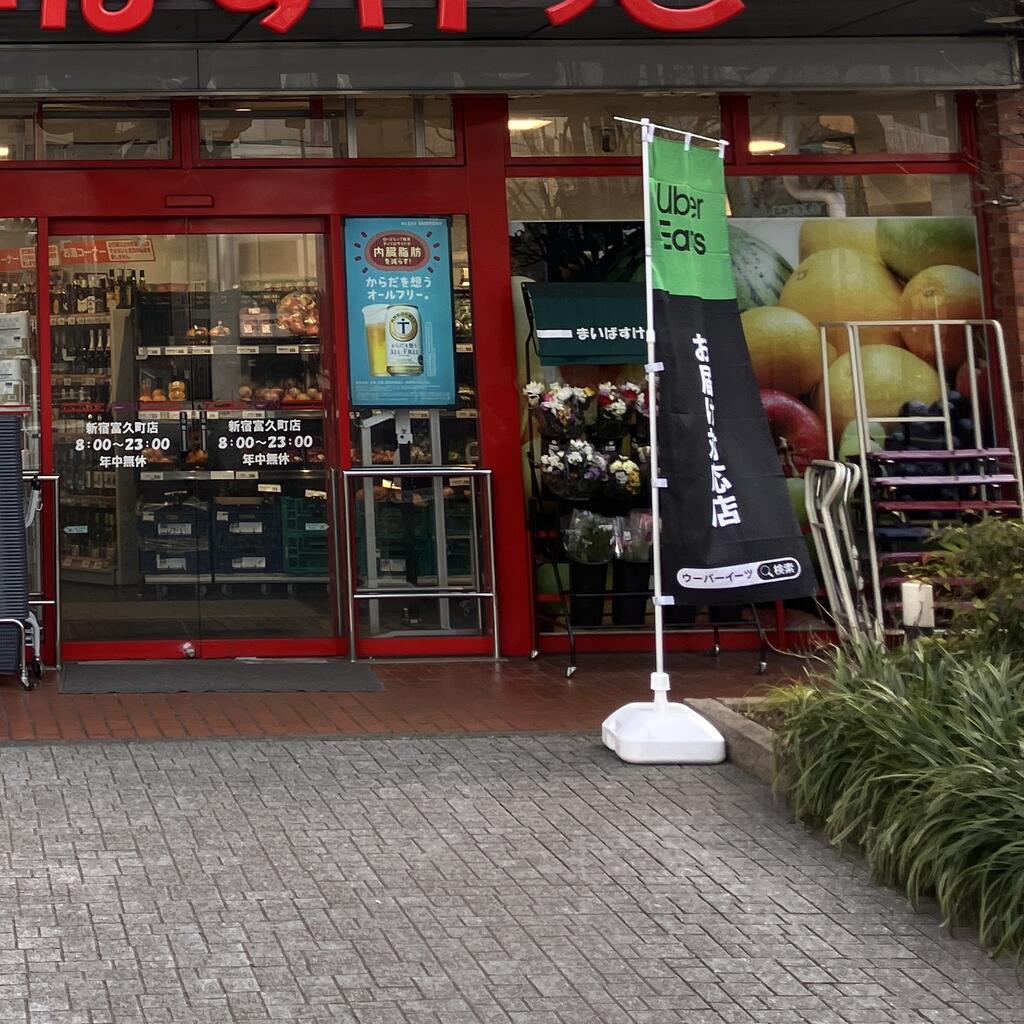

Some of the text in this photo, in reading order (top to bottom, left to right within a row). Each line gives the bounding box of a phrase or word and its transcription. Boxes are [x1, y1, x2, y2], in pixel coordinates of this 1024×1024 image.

[659, 219, 706, 255] Eas
[373, 246, 422, 258] 内臓脂肪
[366, 276, 432, 288] からだを想う
[576, 326, 646, 340] まいばすけ
[85, 421, 159, 434] 新宿富久町店
[228, 419, 302, 433] 新宿富久町店
[99, 455, 147, 468] 年中無休
[242, 453, 290, 466] 年中無休
[773, 562, 795, 575] 検索
[682, 569, 753, 583] ウーバーイーツ
